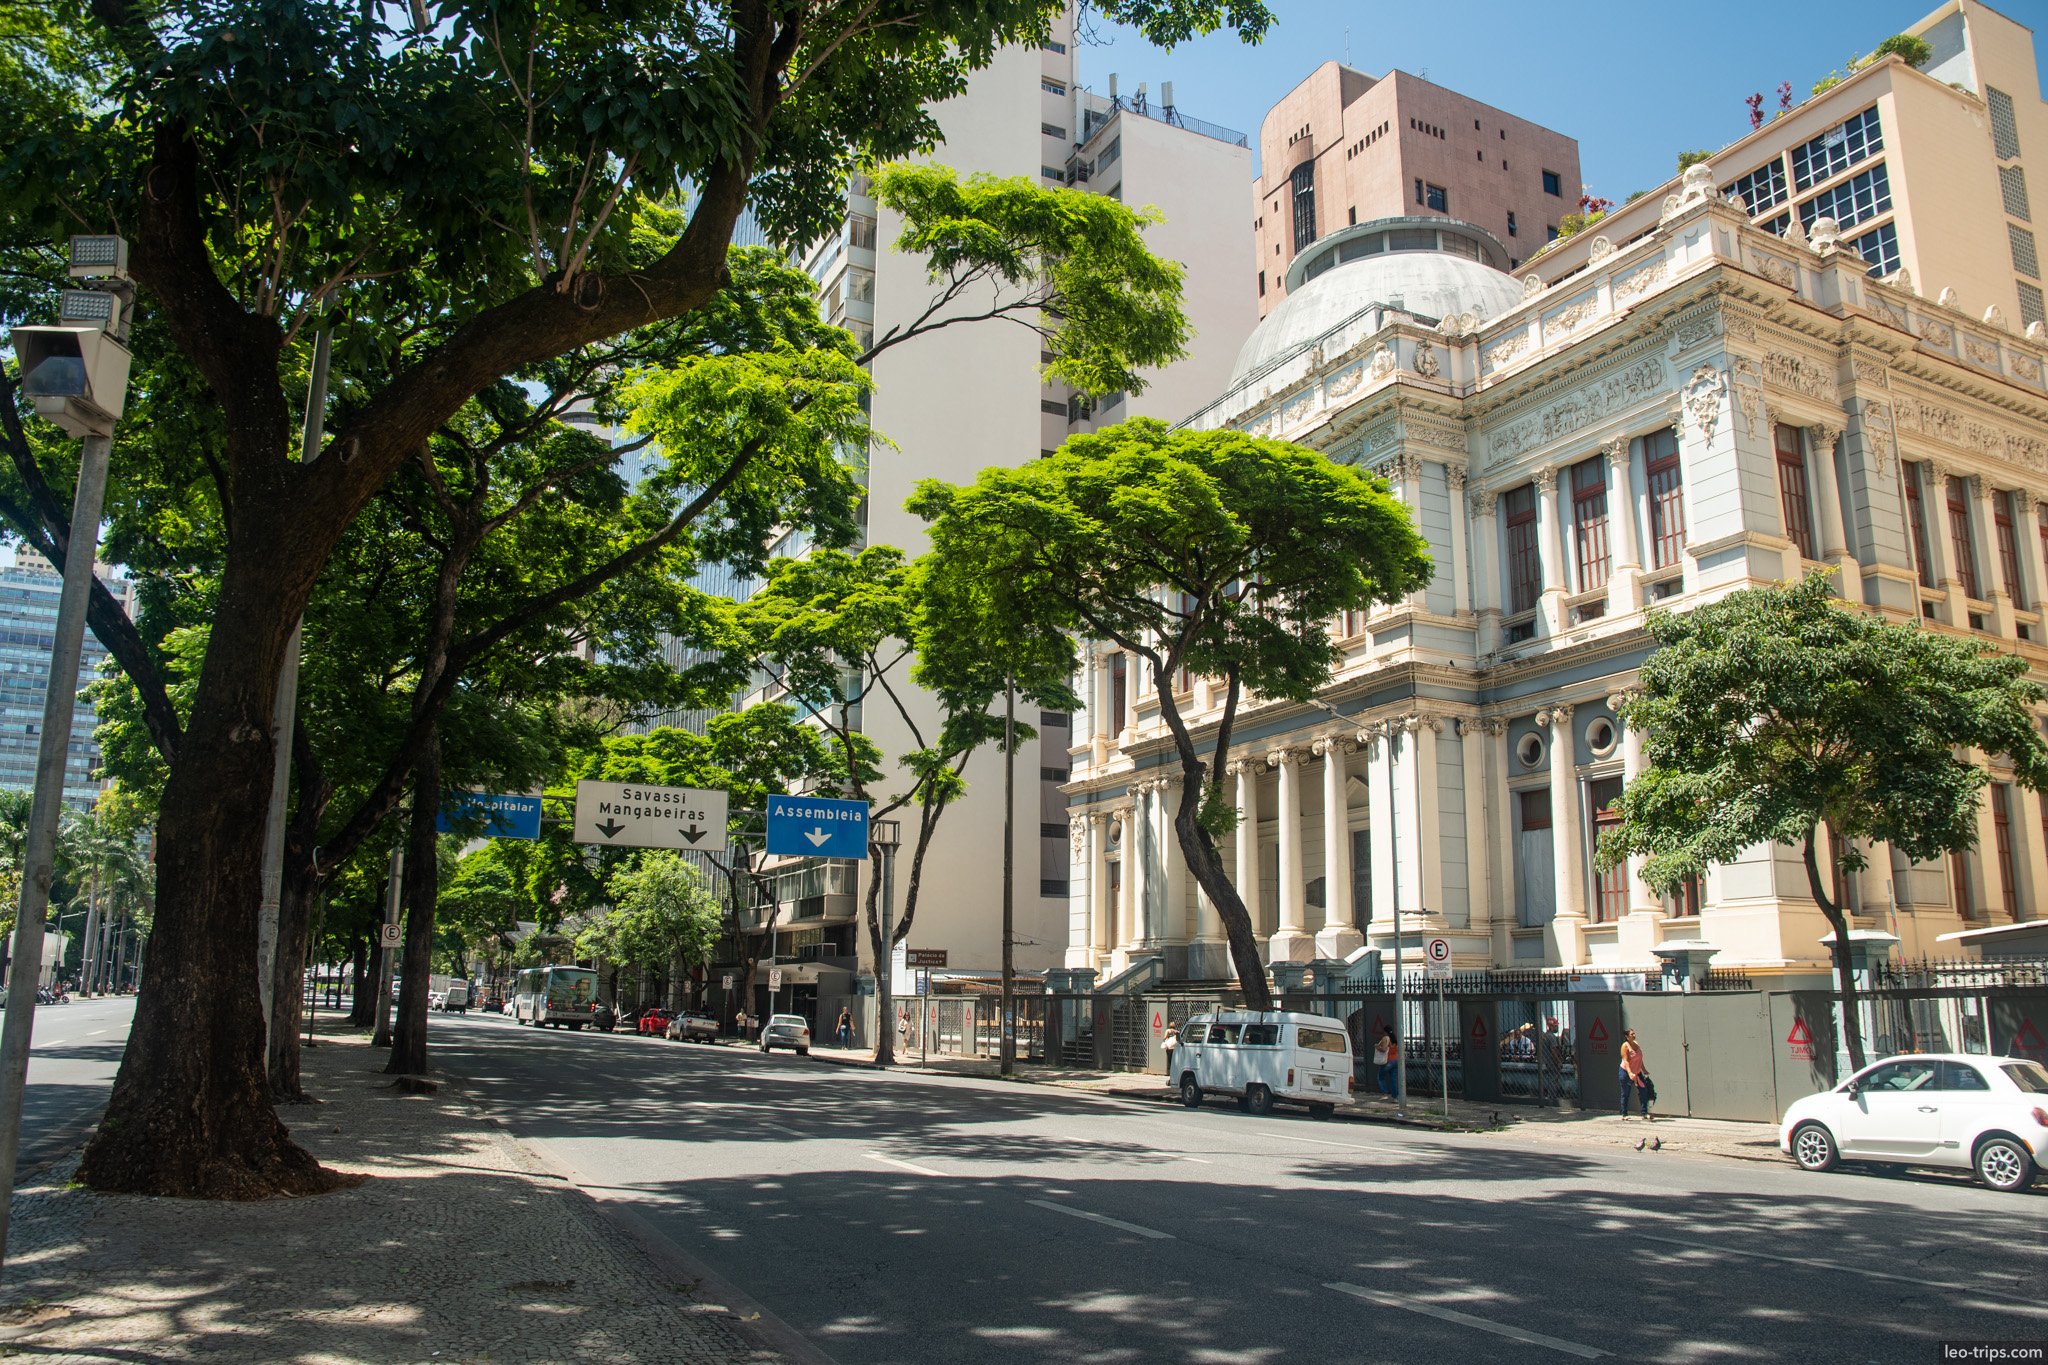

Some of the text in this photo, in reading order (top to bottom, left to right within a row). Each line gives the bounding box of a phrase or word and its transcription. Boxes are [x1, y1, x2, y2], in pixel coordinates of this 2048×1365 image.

[622, 788, 686, 804] Savassi
[599, 802, 705, 820] Mangabeiras
[774, 804, 862, 822] Assembleia
[388, 927, 396, 938] E
[1435, 943, 1443, 957] E
[1790, 1046, 1812, 1054] TJMG
